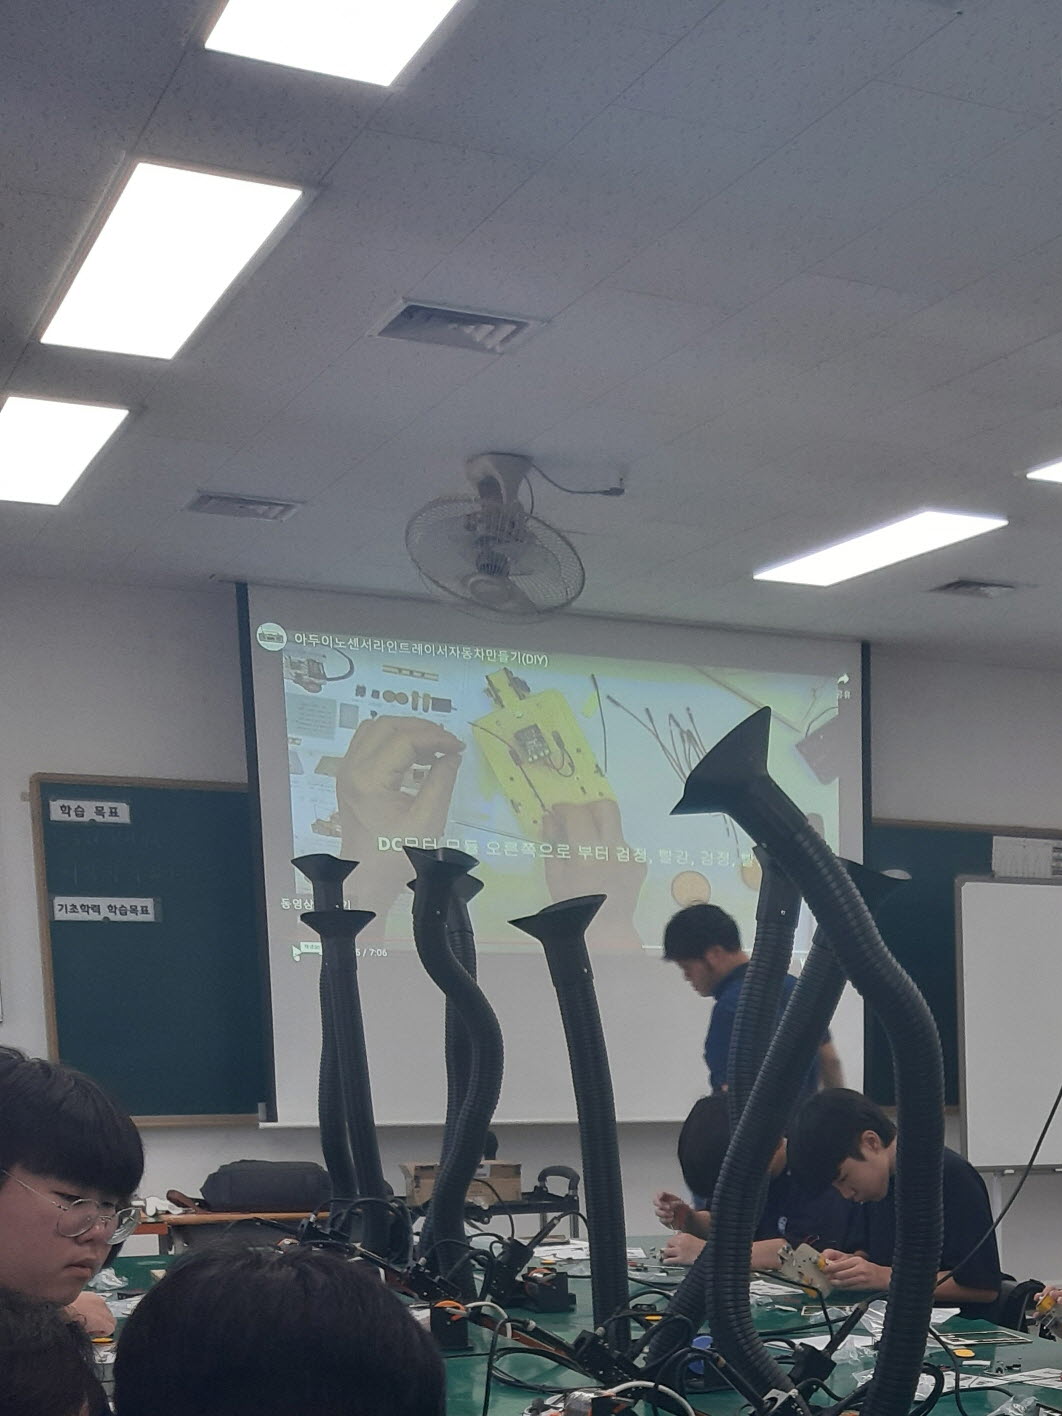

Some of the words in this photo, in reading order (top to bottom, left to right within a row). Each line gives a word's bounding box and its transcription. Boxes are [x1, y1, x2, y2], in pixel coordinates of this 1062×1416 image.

[60, 804, 85, 818] 학습
[94, 805, 120, 819] 목표
[487, 840, 571, 859] 오른쪽으로
[577, 844, 609, 862] 부터
[57, 903, 101, 916] 기초학력
[107, 903, 151, 916] 학습목표
[369, 948, 388, 957] 7:06
